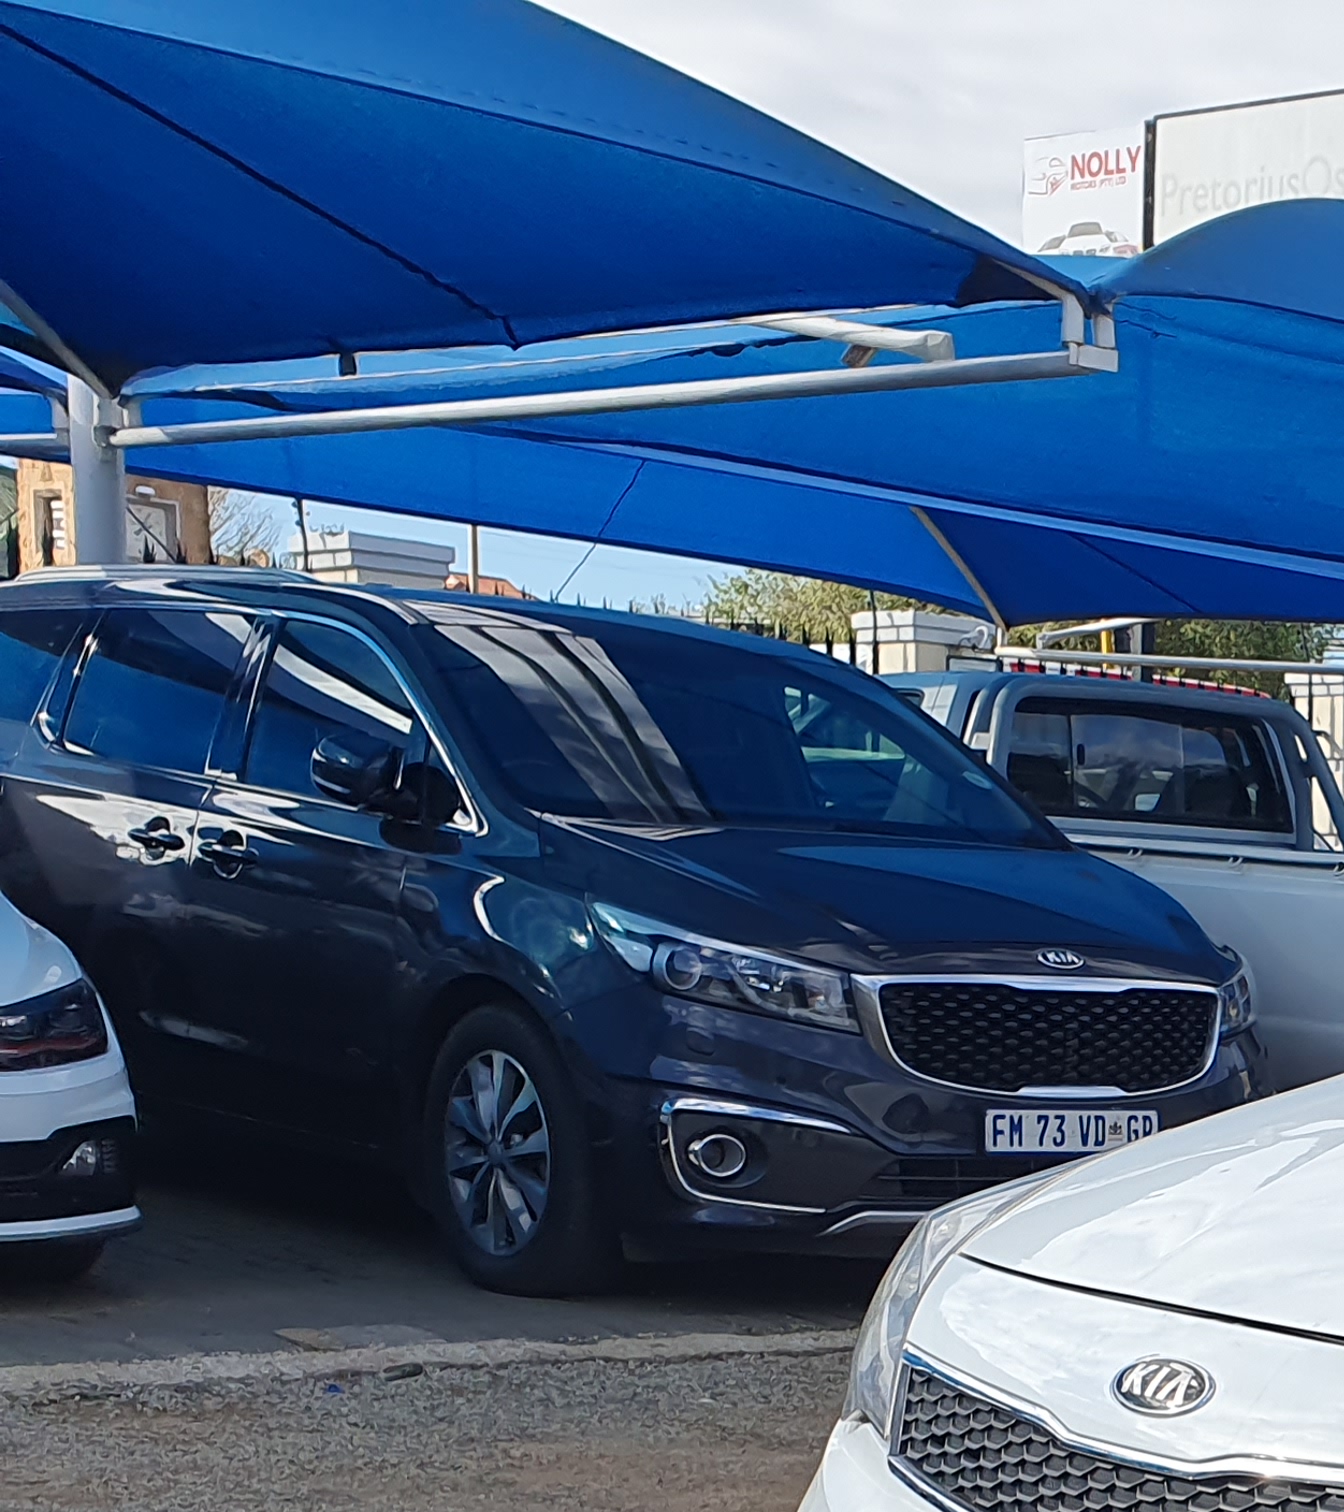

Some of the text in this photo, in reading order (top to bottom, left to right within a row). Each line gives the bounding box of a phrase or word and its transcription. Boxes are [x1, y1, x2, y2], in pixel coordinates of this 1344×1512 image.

[1070, 145, 1142, 181] NOLLY
[1046, 950, 1080, 964] KIA
[992, 1114, 1154, 1148] FM 73 VD GP
[1120, 1361, 1197, 1408] KIA
